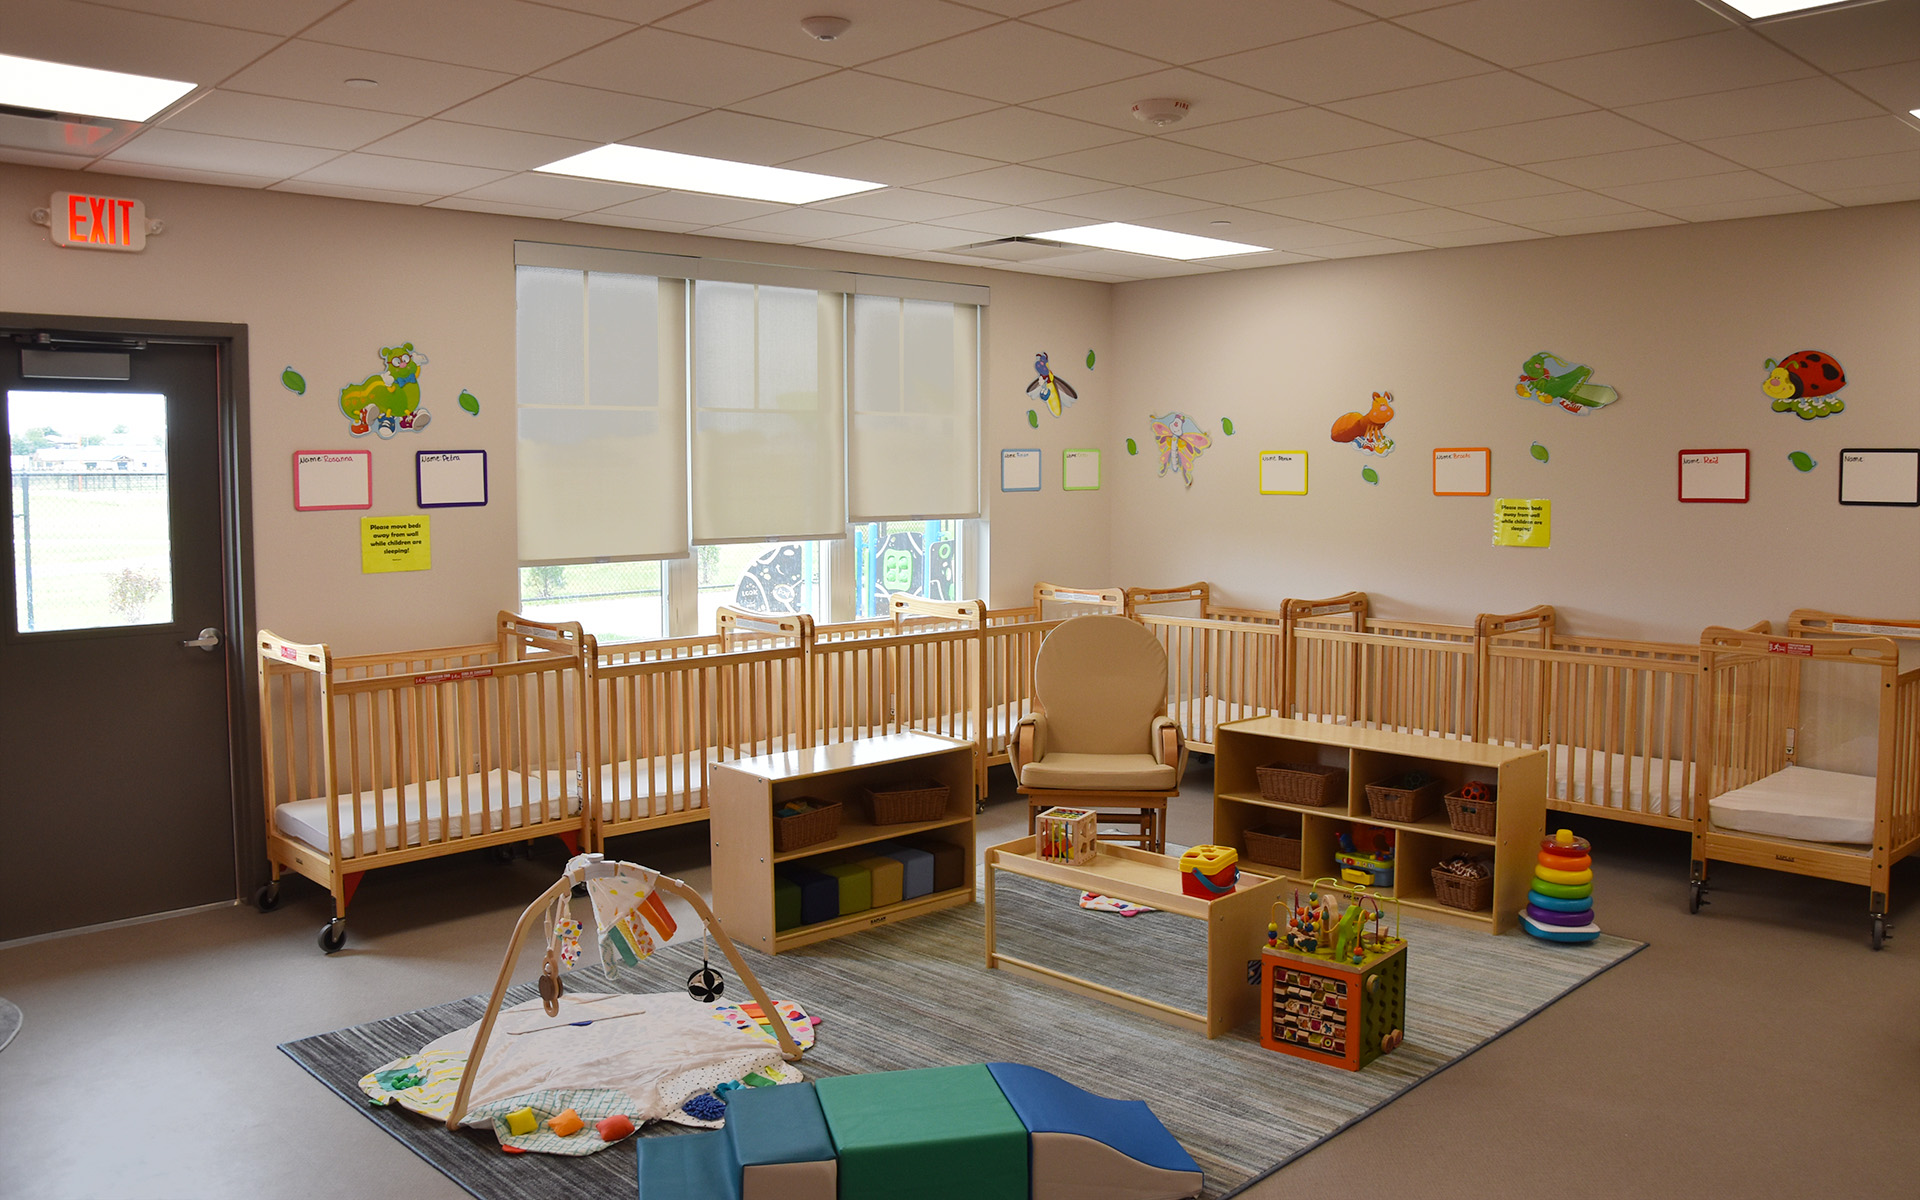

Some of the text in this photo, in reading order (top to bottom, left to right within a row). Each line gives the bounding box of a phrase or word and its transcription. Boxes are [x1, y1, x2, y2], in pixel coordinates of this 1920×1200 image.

[68, 194, 134, 246] EXIT
[323, 454, 353, 463] Rosanna
[442, 454, 461, 462] Petra
[384, 547, 410, 555] sleeping!
